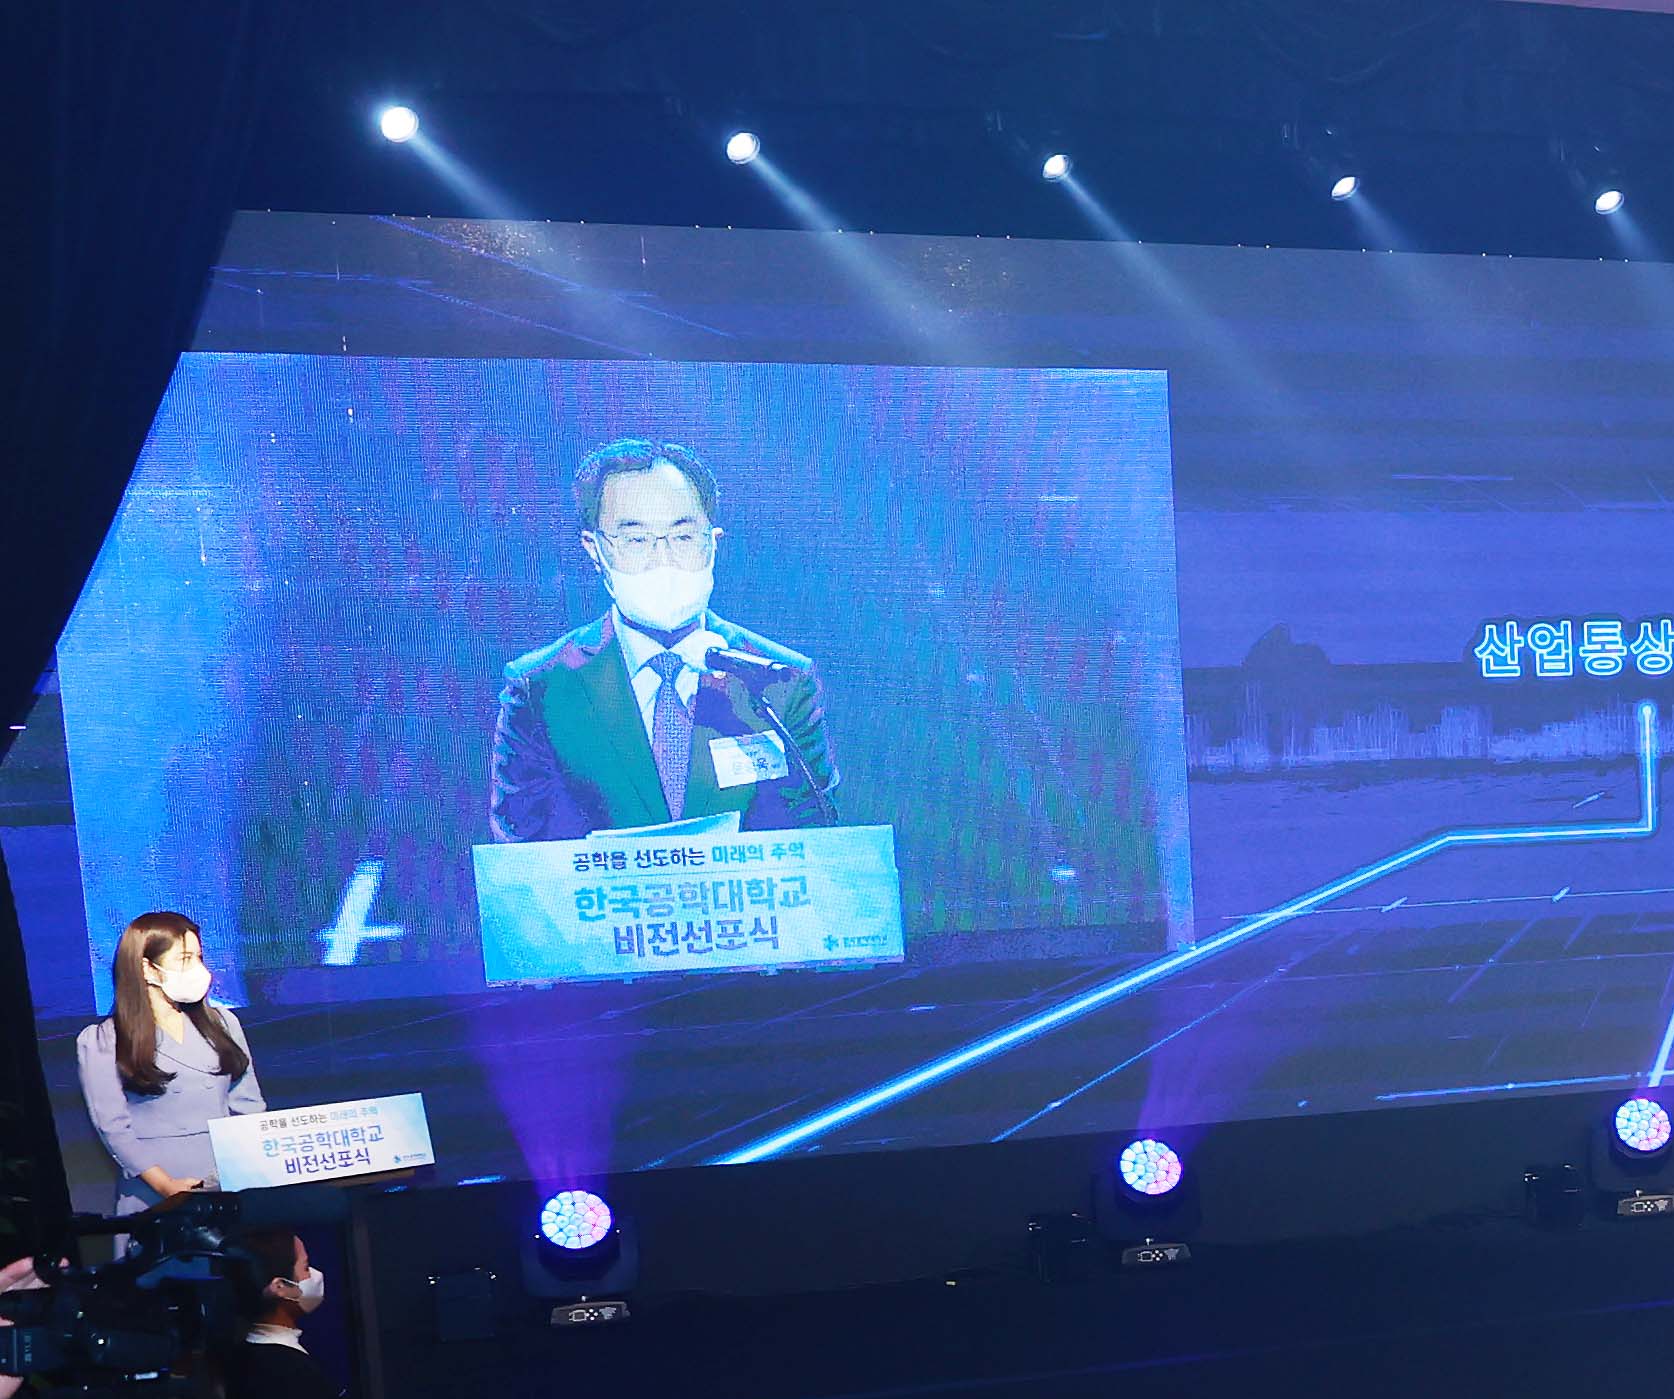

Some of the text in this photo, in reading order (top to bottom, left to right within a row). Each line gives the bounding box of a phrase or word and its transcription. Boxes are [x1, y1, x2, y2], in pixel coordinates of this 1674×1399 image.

[572, 841, 806, 873] 공학을 선도하는 미래의 주역
[573, 875, 812, 923] 한국공학대학교
[613, 914, 781, 959] 비전선포식
[259, 1116, 288, 1132] 공학을
[291, 1112, 328, 1128] 선도하는
[262, 1124, 385, 1158] 한국공학대학교
[284, 1147, 373, 1176] 비전선포식
